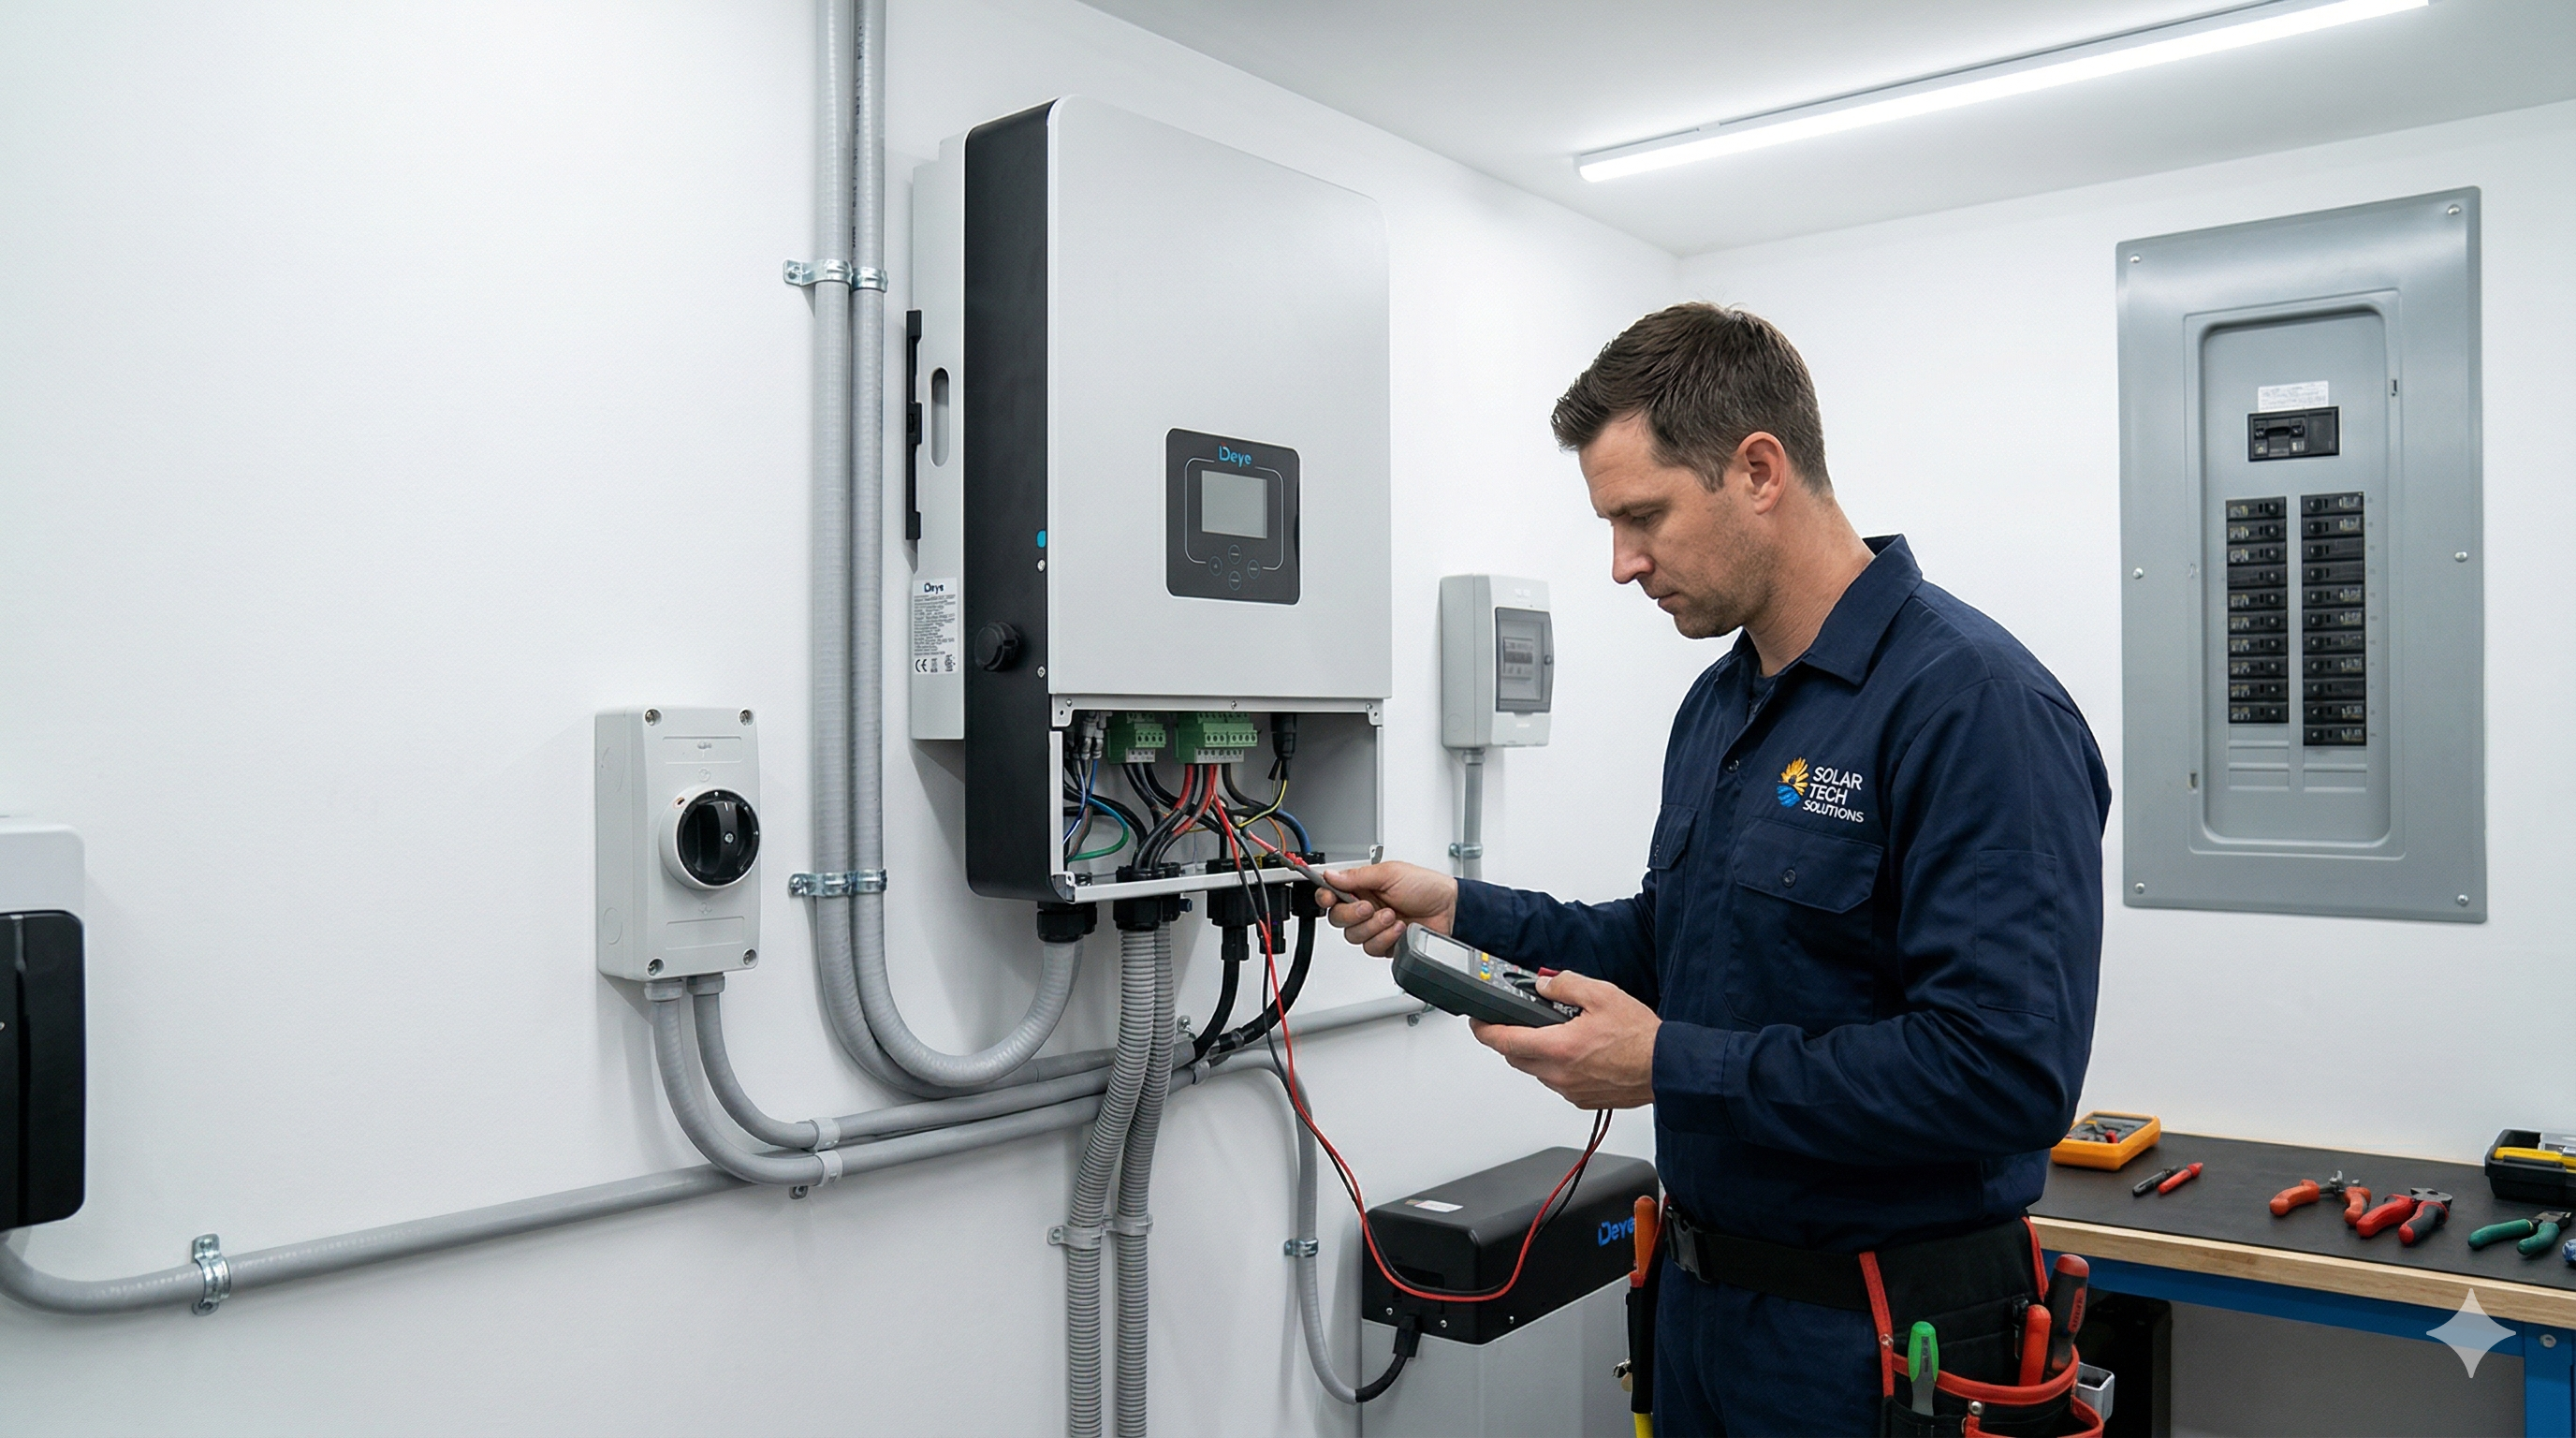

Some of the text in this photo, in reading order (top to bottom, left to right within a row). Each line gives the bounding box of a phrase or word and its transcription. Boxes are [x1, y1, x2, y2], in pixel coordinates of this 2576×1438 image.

[1219, 445, 1251, 468] Deye
[1812, 766, 1864, 790] SOLAR
[1808, 783, 1849, 805] TECH
[1802, 800, 1865, 823] SOLUTIONS
[1597, 1216, 1635, 1247] Deye
